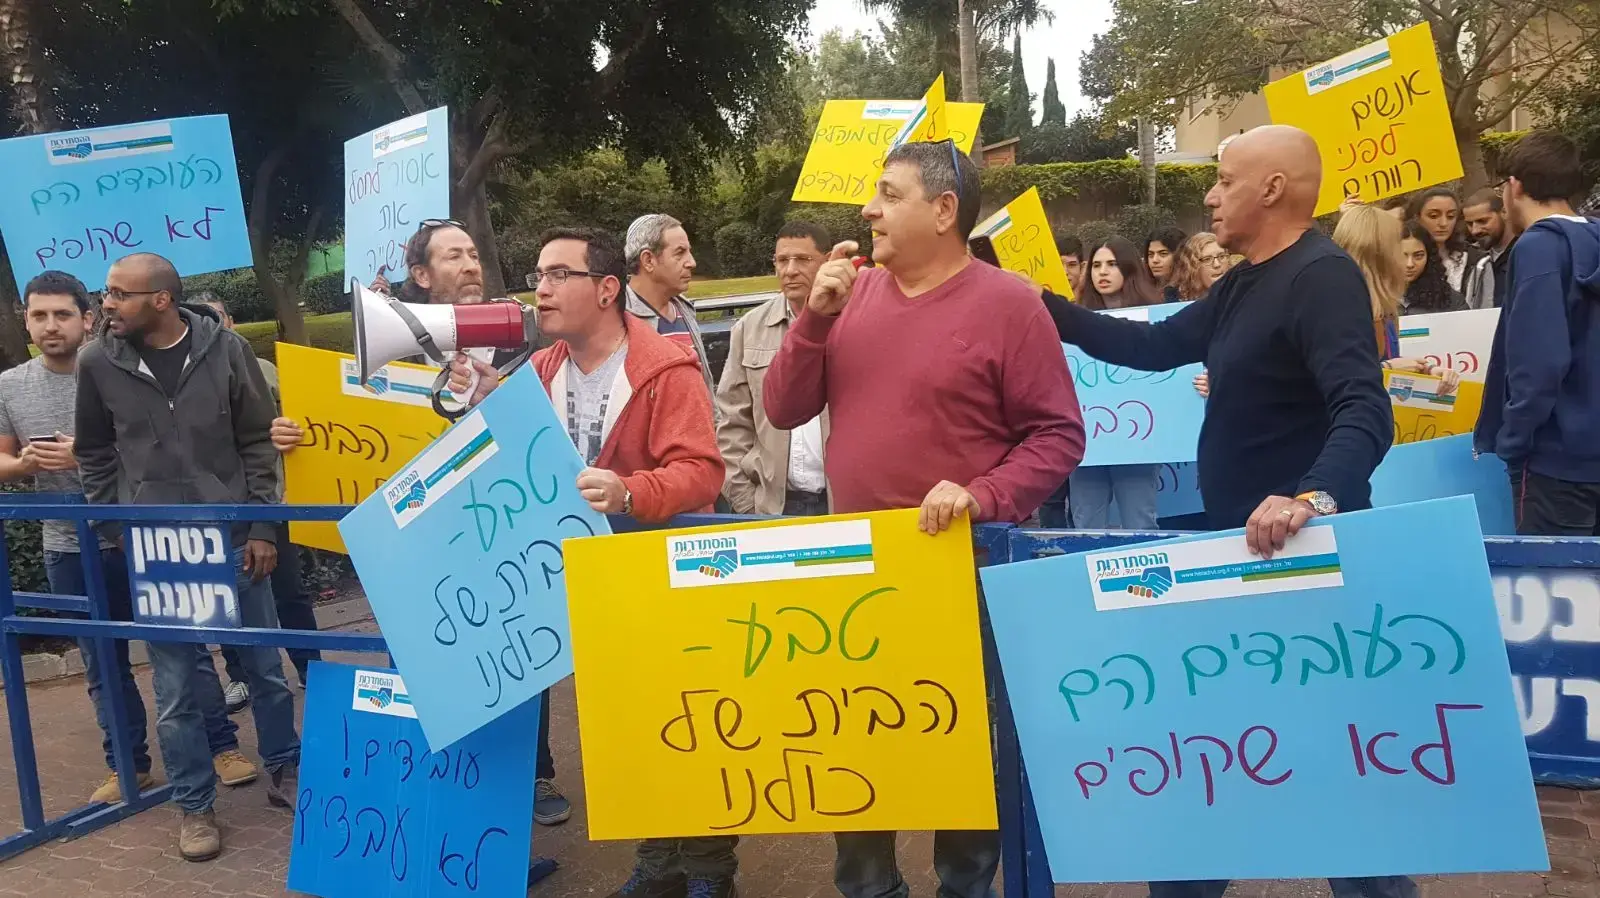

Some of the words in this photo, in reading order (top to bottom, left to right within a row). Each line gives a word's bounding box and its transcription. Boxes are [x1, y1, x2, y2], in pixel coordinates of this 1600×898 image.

[1351, 69, 1430, 131] אנשים
[814, 125, 865, 146] מנהלים
[1337, 122, 1405, 171] לפני
[96, 153, 222, 197] העובדים
[387, 152, 440, 187] אסור
[798, 171, 868, 197] עובדים
[30, 181, 80, 216] הם
[378, 201, 410, 231] את
[35, 221, 143, 268] שקופים
[165, 206, 225, 243] לא
[296, 416, 389, 463] הבית
[1082, 400, 1154, 441] הבי
[131, 527, 227, 574] בטחון
[675, 537, 737, 553] ההסתדרות
[1096, 552, 1169, 572] ההסתדרות
[136, 580, 237, 625] רעננה
[434, 575, 489, 646] של
[475, 613, 563, 708] כולנו
[1180, 602, 1466, 697] העובדים
[782, 679, 958, 738] הבית
[1058, 652, 1156, 723] הם
[660, 688, 761, 752] של
[1073, 724, 1293, 807] שקופים
[1347, 702, 1485, 786] לא
[709, 748, 876, 830] כולנו
[298, 788, 411, 882] עבדים
[439, 827, 509, 891] לא
